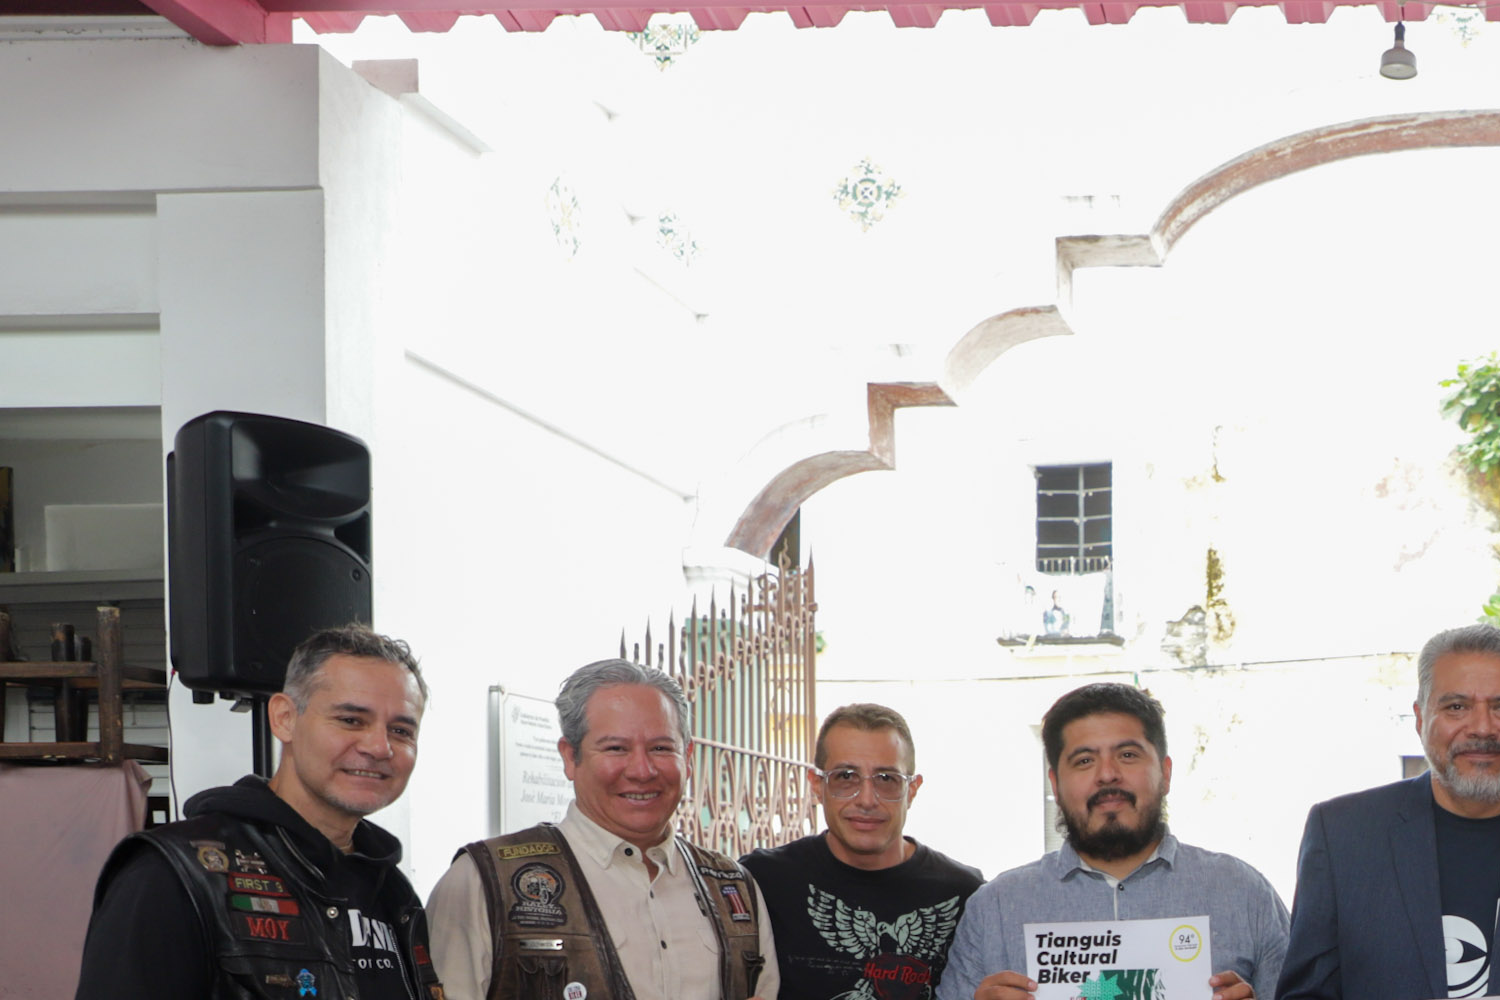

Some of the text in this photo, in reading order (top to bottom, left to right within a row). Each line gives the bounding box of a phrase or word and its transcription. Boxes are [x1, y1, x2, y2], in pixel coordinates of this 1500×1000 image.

[235, 878, 269, 891] FIRST
[246, 917, 289, 940] MOY
[1036, 931, 1122, 951] Tianguis
[1037, 950, 1117, 966] Cultural
[864, 963, 931, 985] Hard Rock
[1038, 968, 1090, 984] Biker
